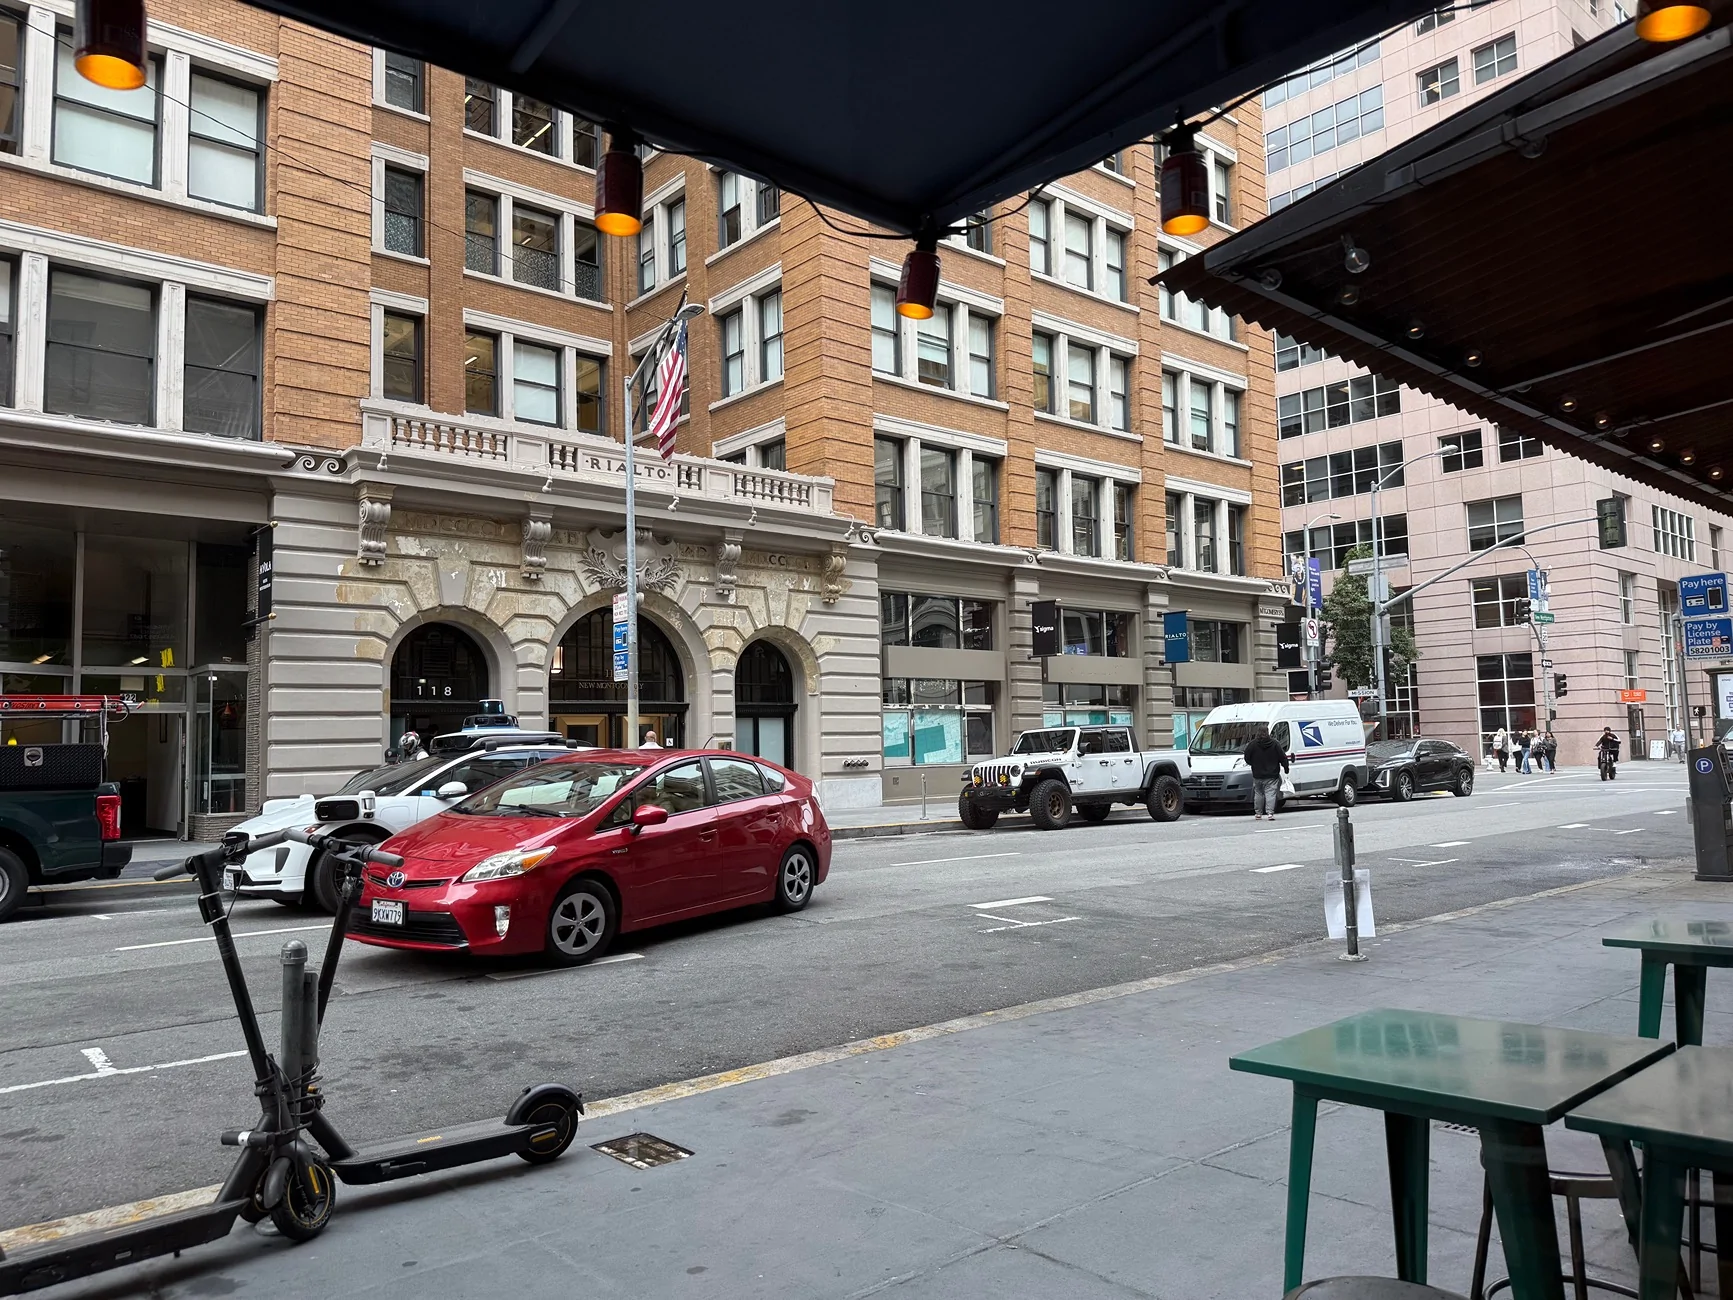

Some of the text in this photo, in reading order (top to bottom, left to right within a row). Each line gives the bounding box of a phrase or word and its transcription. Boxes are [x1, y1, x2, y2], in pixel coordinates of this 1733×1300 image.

[590, 458, 666, 480] RIALTO
[1682, 577, 1724, 589] Pay here
[1687, 621, 1718, 631] Pay by
[1688, 629, 1721, 638] License
[1688, 637, 1711, 646] Plate
[1690, 645, 1730, 654] 58201003
[417, 686, 452, 696] 118
[1701, 761, 1709, 770] P
[373, 907, 402, 922] 9KXW779
